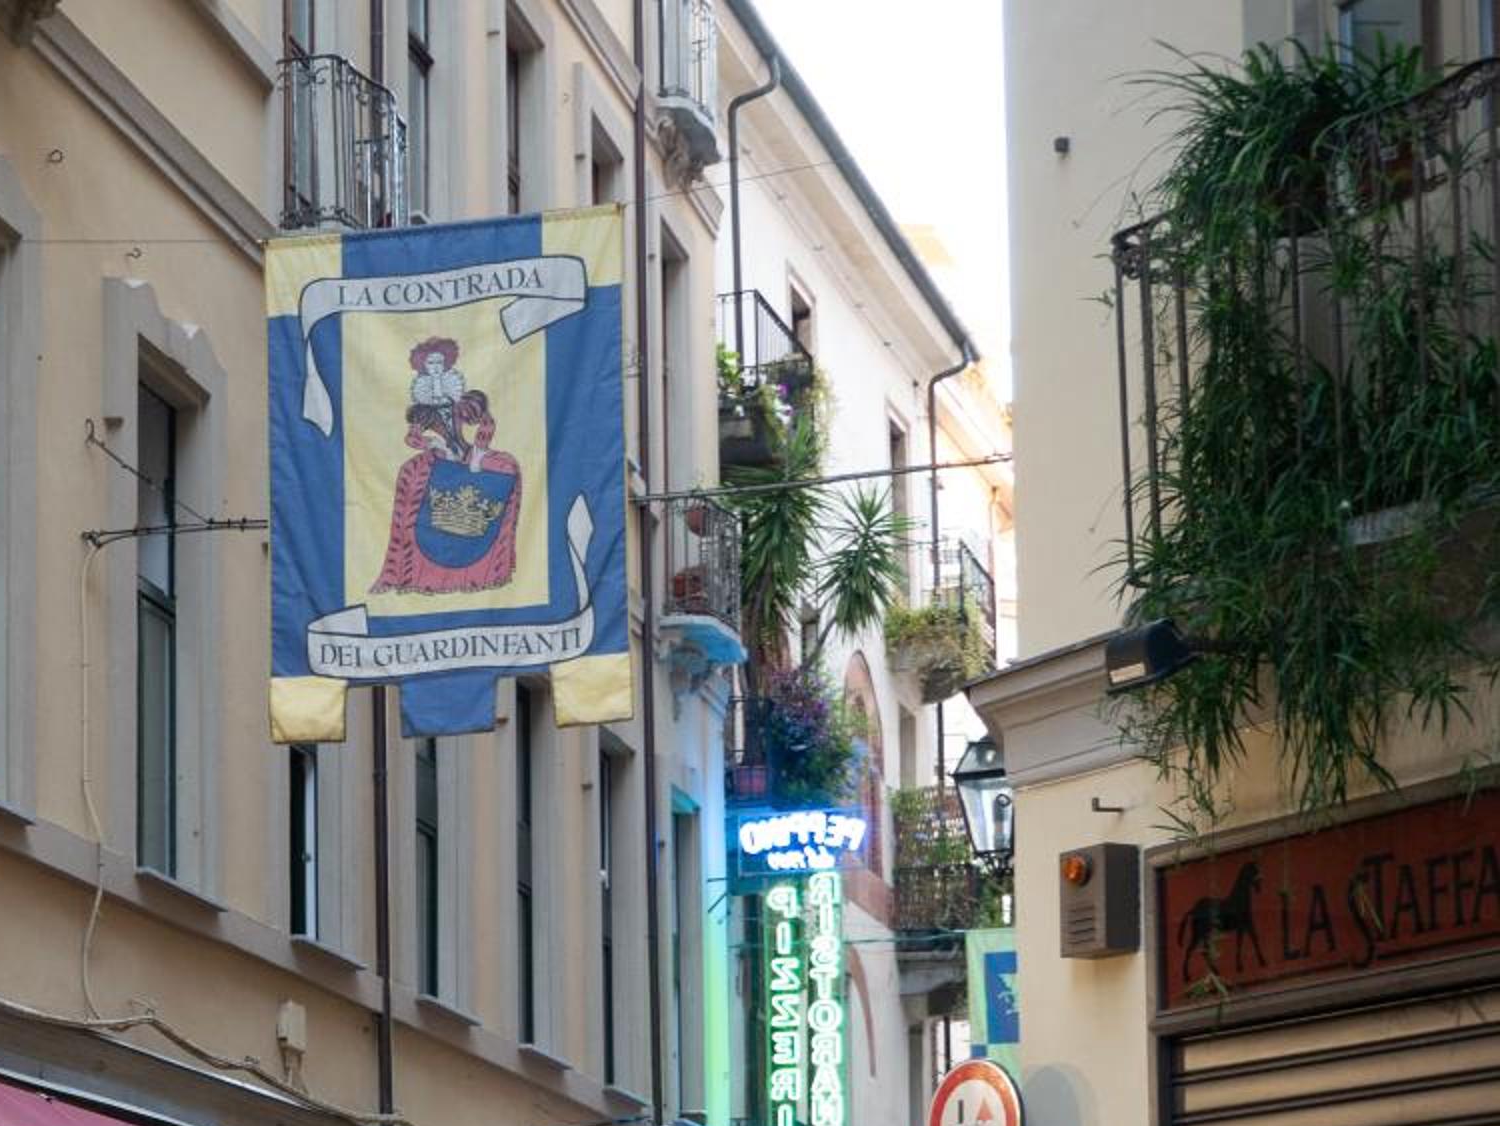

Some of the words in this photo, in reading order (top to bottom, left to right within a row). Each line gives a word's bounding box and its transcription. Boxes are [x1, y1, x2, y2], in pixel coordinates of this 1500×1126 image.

[337, 284, 374, 307] LA
[382, 265, 544, 307] CONTRADA
[319, 642, 363, 668] DEI
[372, 626, 583, 670] GUARDINFANTI
[1278, 883, 1336, 961] LA
